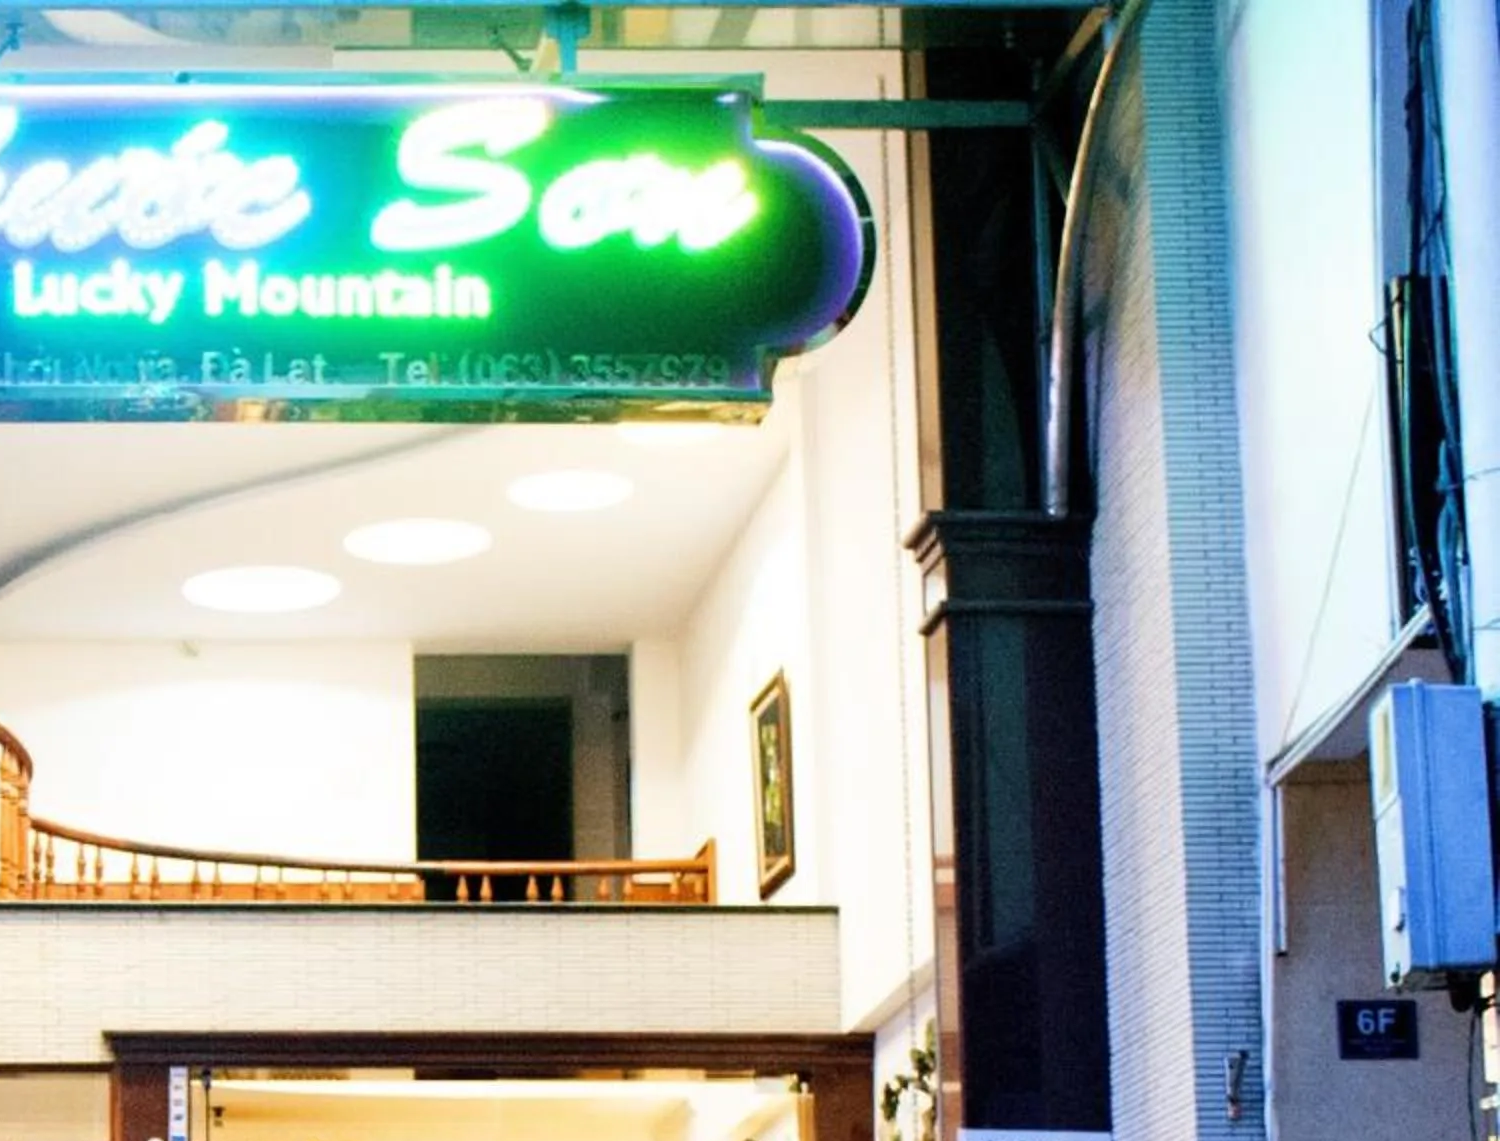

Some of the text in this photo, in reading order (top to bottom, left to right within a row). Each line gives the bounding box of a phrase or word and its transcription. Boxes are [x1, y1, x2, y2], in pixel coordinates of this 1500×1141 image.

[13, 258, 491, 324] Lucky Mountain
[1357, 1007, 1396, 1036] 6F
